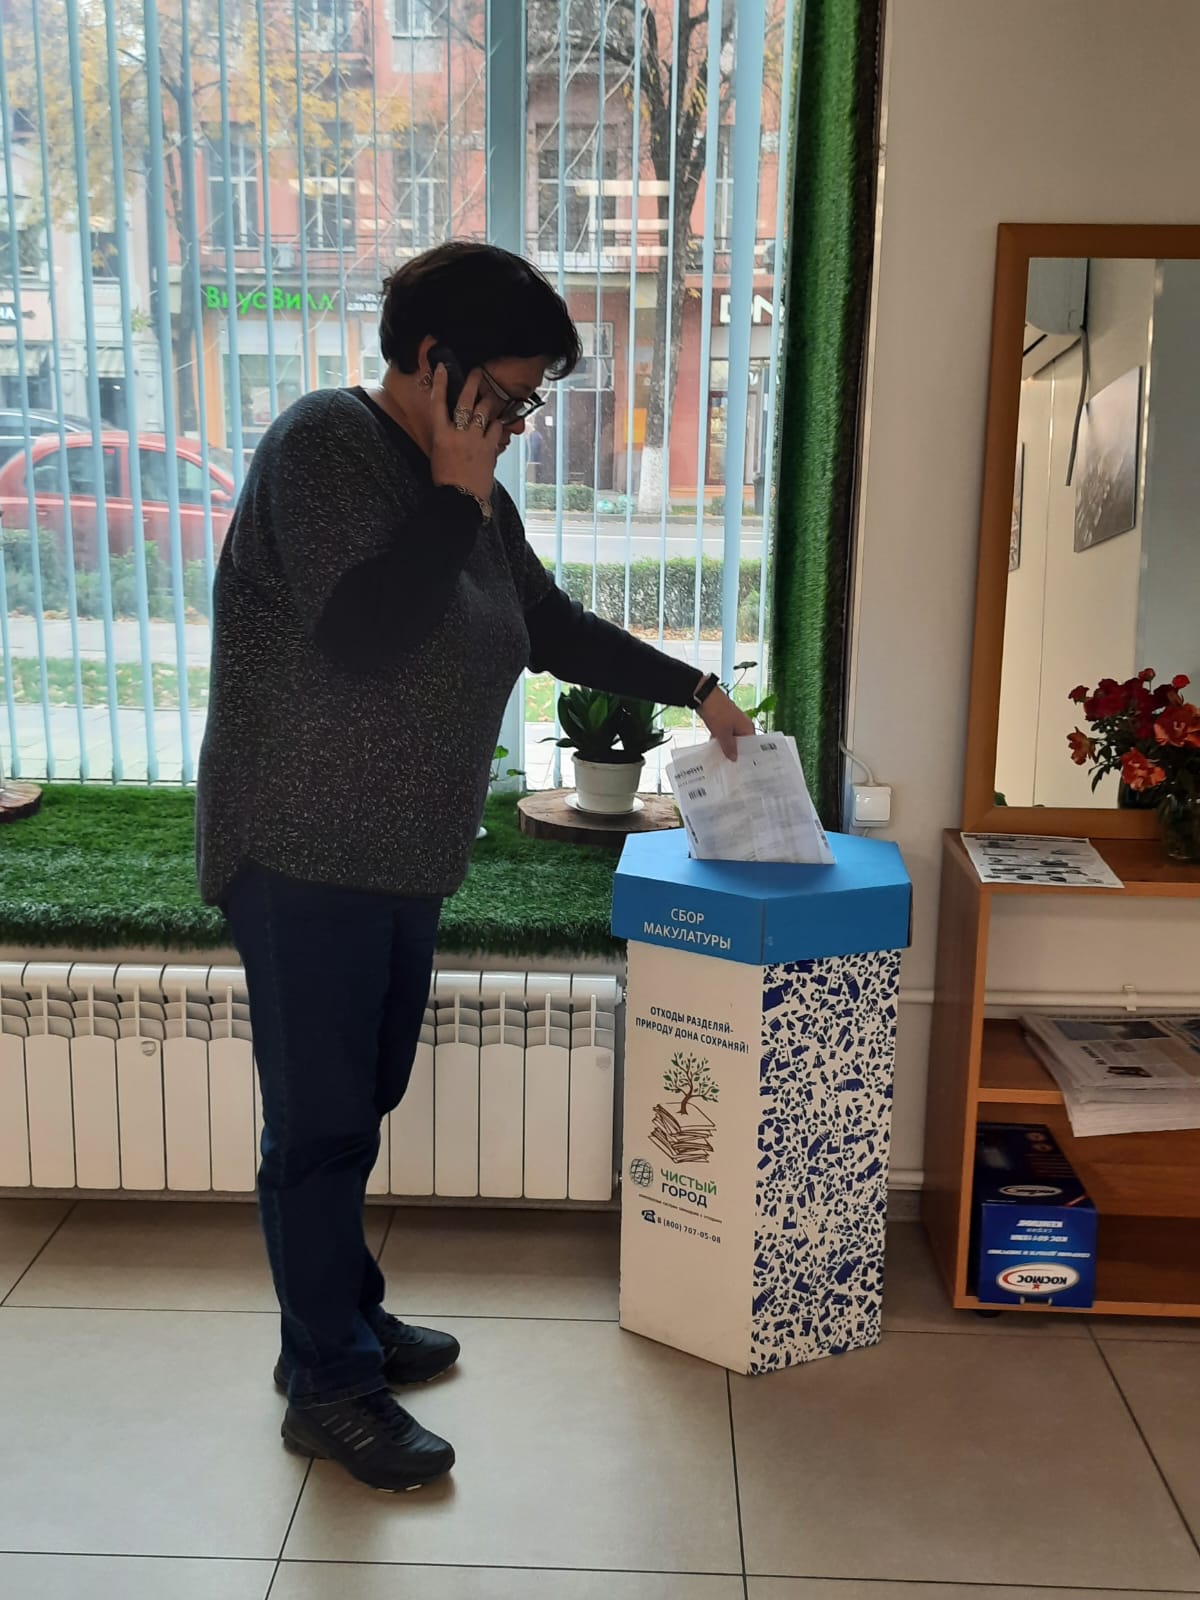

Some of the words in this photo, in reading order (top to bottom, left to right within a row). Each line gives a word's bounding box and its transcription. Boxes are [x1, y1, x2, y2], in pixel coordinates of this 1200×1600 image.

[670, 908, 705, 925] СБОР
[643, 921, 731, 950] МАКУЛАТУРЫ
[650, 1006, 685, 1023] ОТХОДЫ
[635, 1017, 673, 1035] ПРИРОДУ
[674, 1027, 699, 1042] ДОНА
[700, 1033, 749, 1054] СОХРАНЯЙ!
[660, 1168, 717, 1195] ЧИСТЫЙ
[661, 1183, 708, 1208] ГОРОД
[1017, 1274, 1067, 1285] КОСМОС
